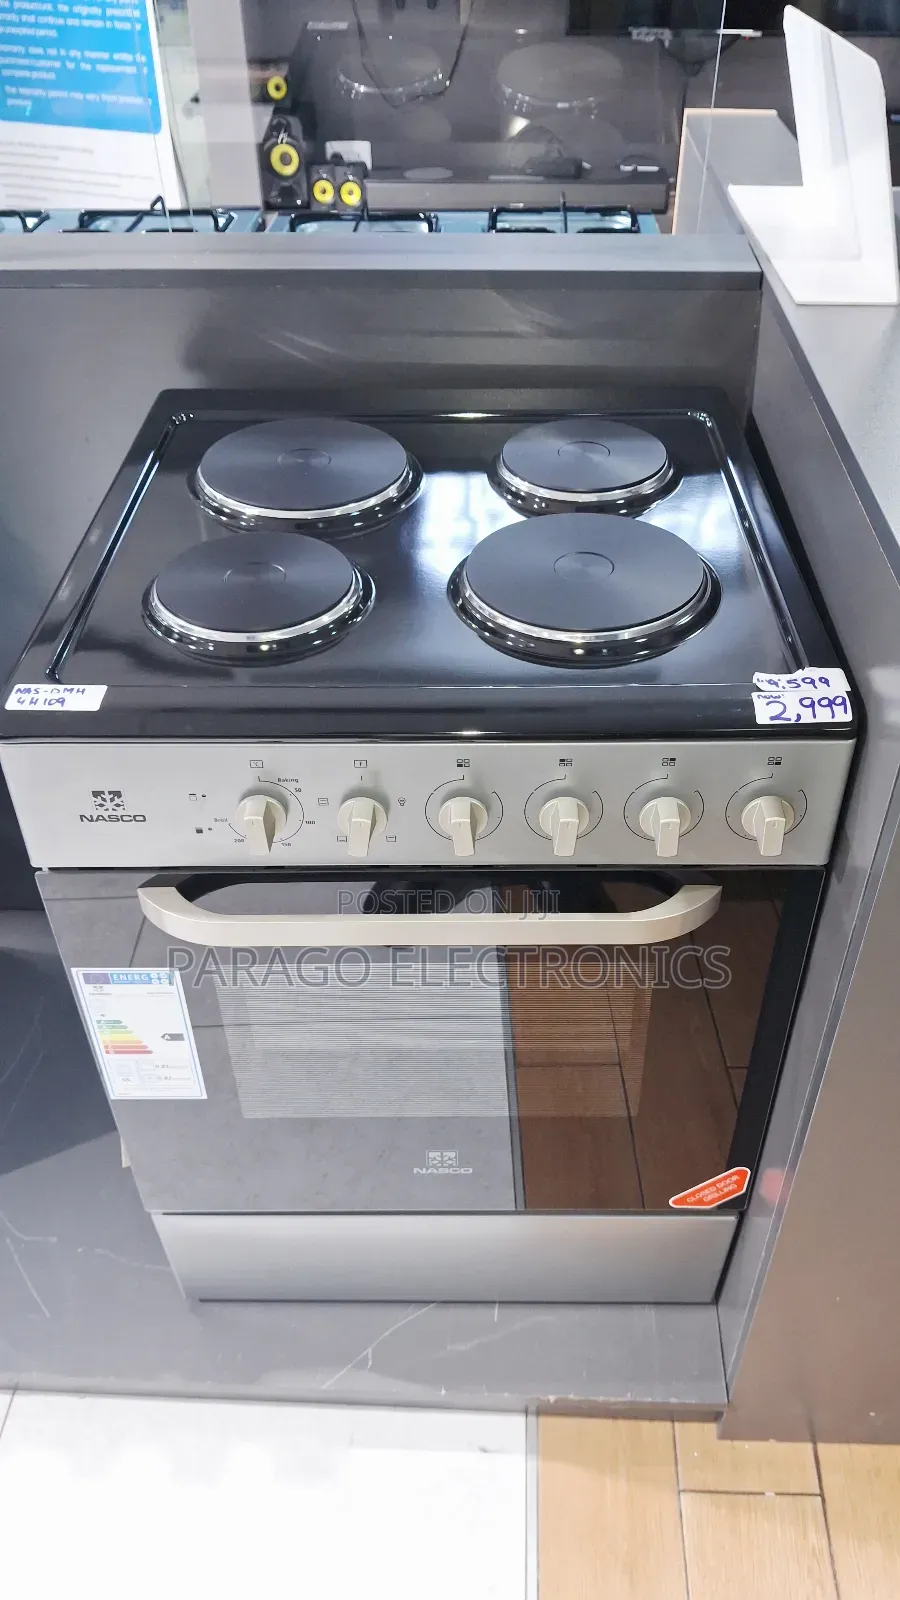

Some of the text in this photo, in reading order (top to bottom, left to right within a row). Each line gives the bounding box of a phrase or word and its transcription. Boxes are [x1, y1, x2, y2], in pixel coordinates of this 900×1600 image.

[766, 696, 848, 722] 2,999
[79, 814, 147, 822] NASCO
[113, 973, 149, 981] ENERG
[686, 1174, 741, 1203] CLOSED DOOR
